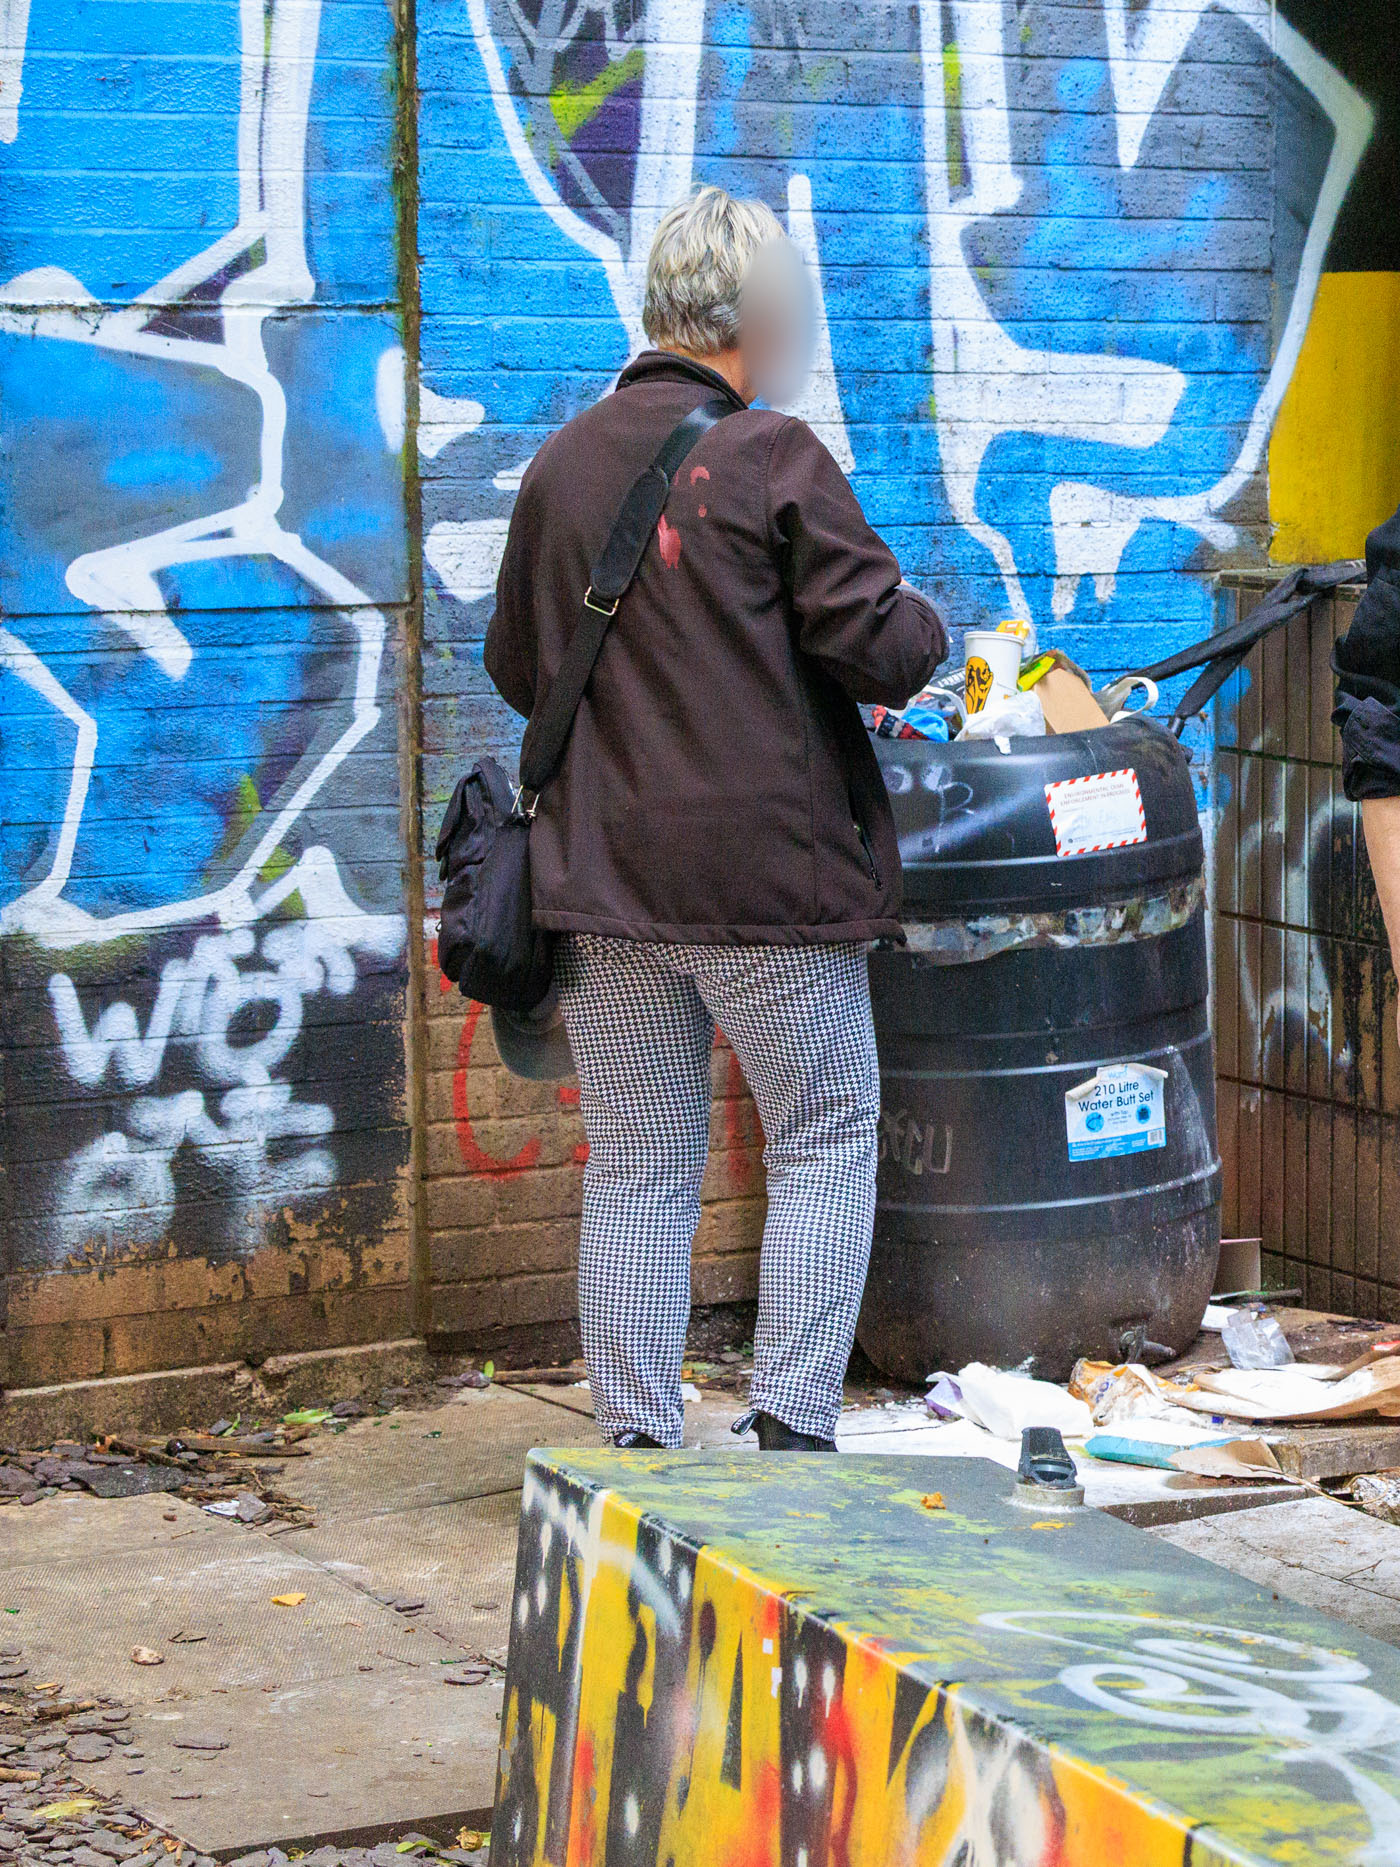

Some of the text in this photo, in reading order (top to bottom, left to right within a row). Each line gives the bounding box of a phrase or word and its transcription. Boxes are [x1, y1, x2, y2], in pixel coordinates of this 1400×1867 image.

[1094, 1081, 1139, 1096] 210 Litre
[1078, 1090, 1154, 1112] Water Butt Set
